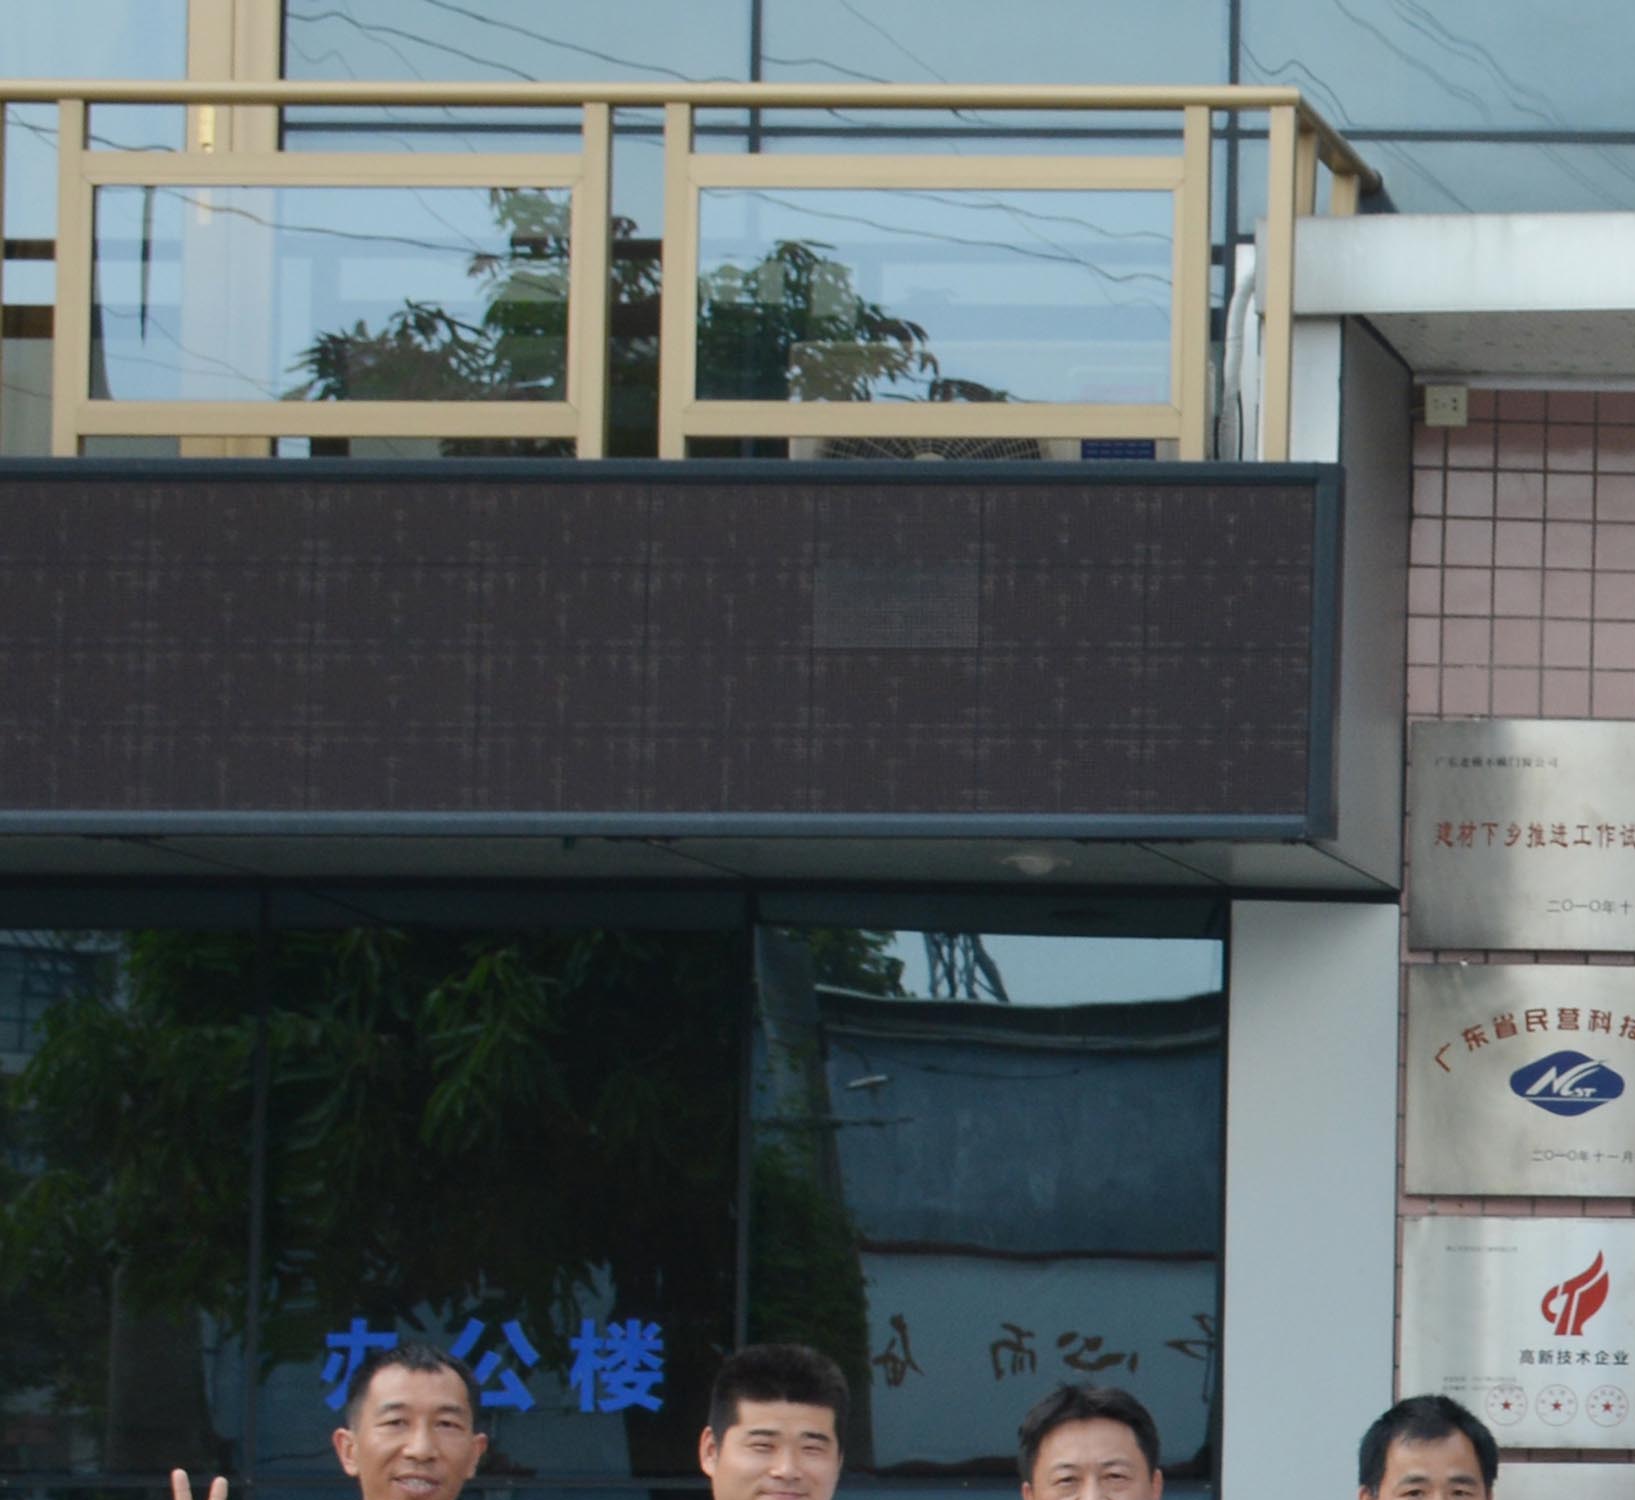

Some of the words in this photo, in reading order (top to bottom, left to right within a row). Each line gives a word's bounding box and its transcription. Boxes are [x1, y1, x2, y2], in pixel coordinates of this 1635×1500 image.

[321, 1317, 664, 1412] 办公楼
[1519, 1349, 1629, 1366] 高新技术企业
